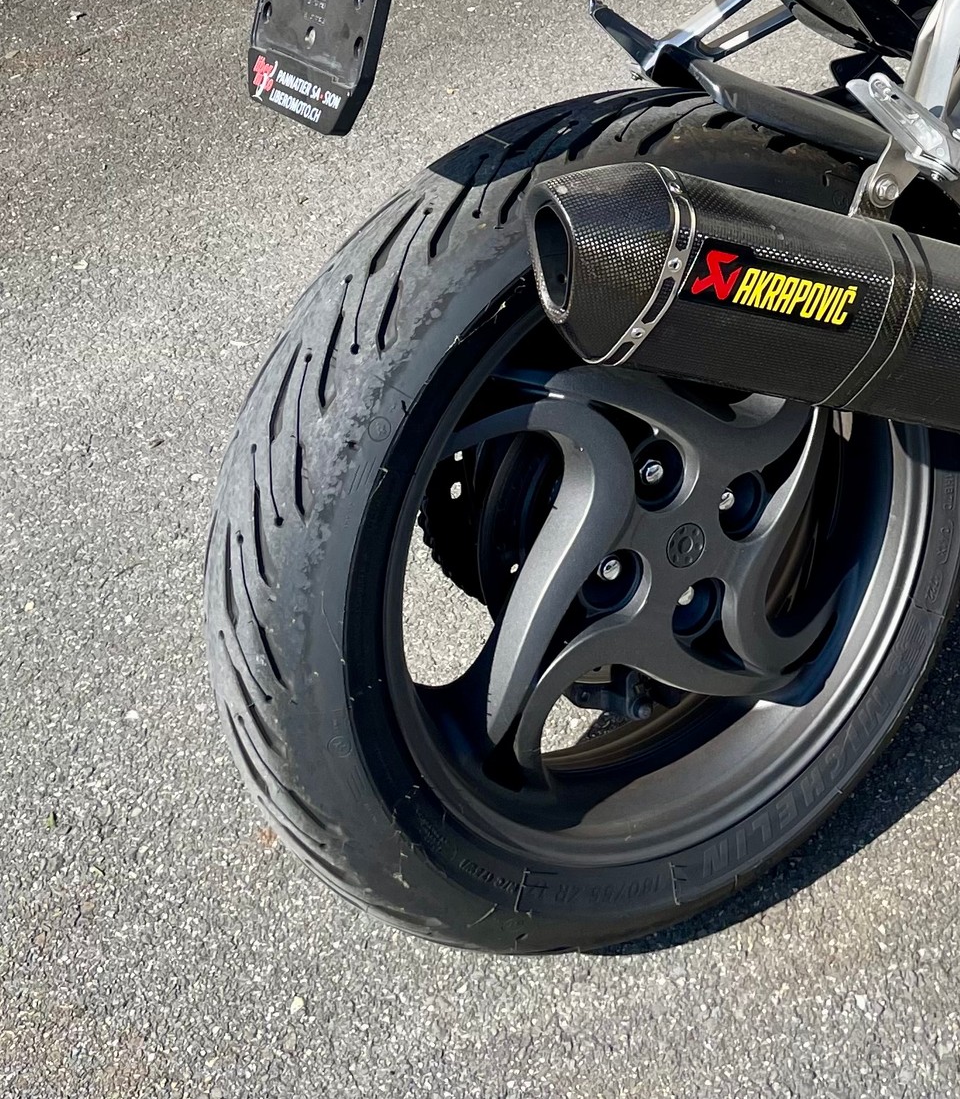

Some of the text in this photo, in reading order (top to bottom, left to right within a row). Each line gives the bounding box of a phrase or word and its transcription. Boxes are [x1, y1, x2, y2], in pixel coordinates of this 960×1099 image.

[268, 88, 322, 123] LIBEROMOTO.CH
[275, 69, 312, 96] PANNATIER
[309, 85, 322, 101] SA
[322, 90, 342, 110] SION
[702, 685, 892, 879] MICHELIN
